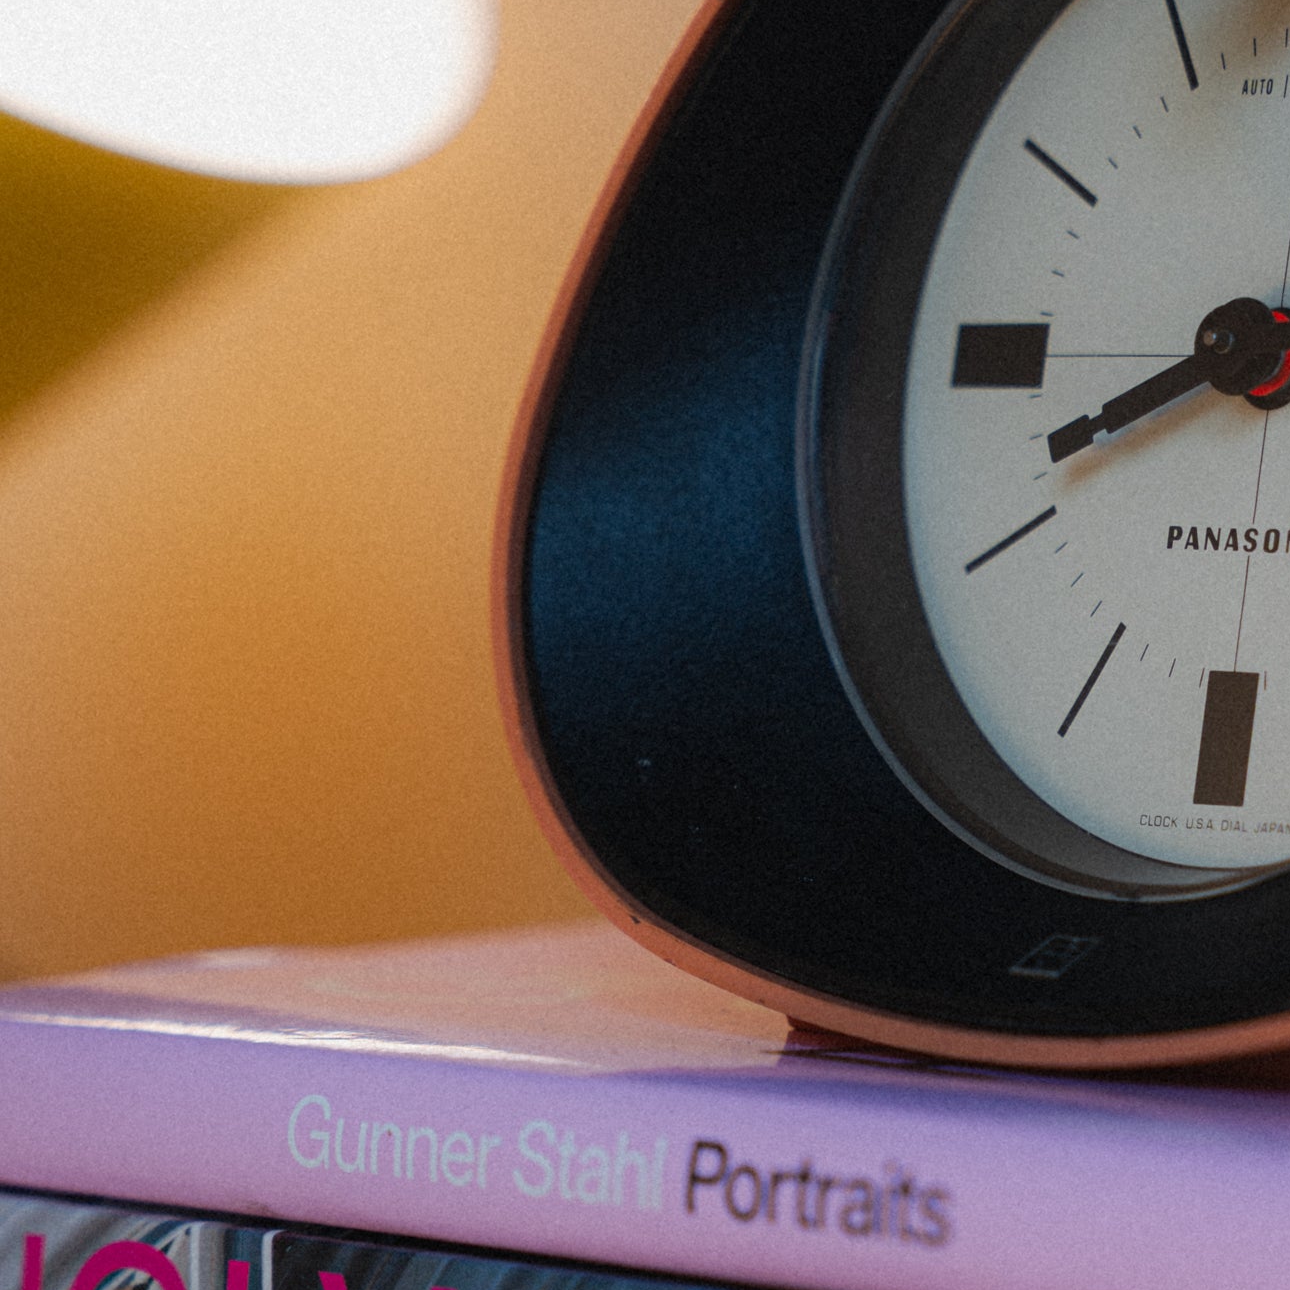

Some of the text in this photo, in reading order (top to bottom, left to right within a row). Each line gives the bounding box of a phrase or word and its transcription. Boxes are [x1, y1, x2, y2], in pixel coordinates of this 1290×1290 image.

[1241, 78, 1275, 96] AUTO
[1139, 814, 1178, 828] CLOCK
[1220, 819, 1248, 833] DIAL
[287, 1094, 954, 1249] Gunner Stahl Portraits
